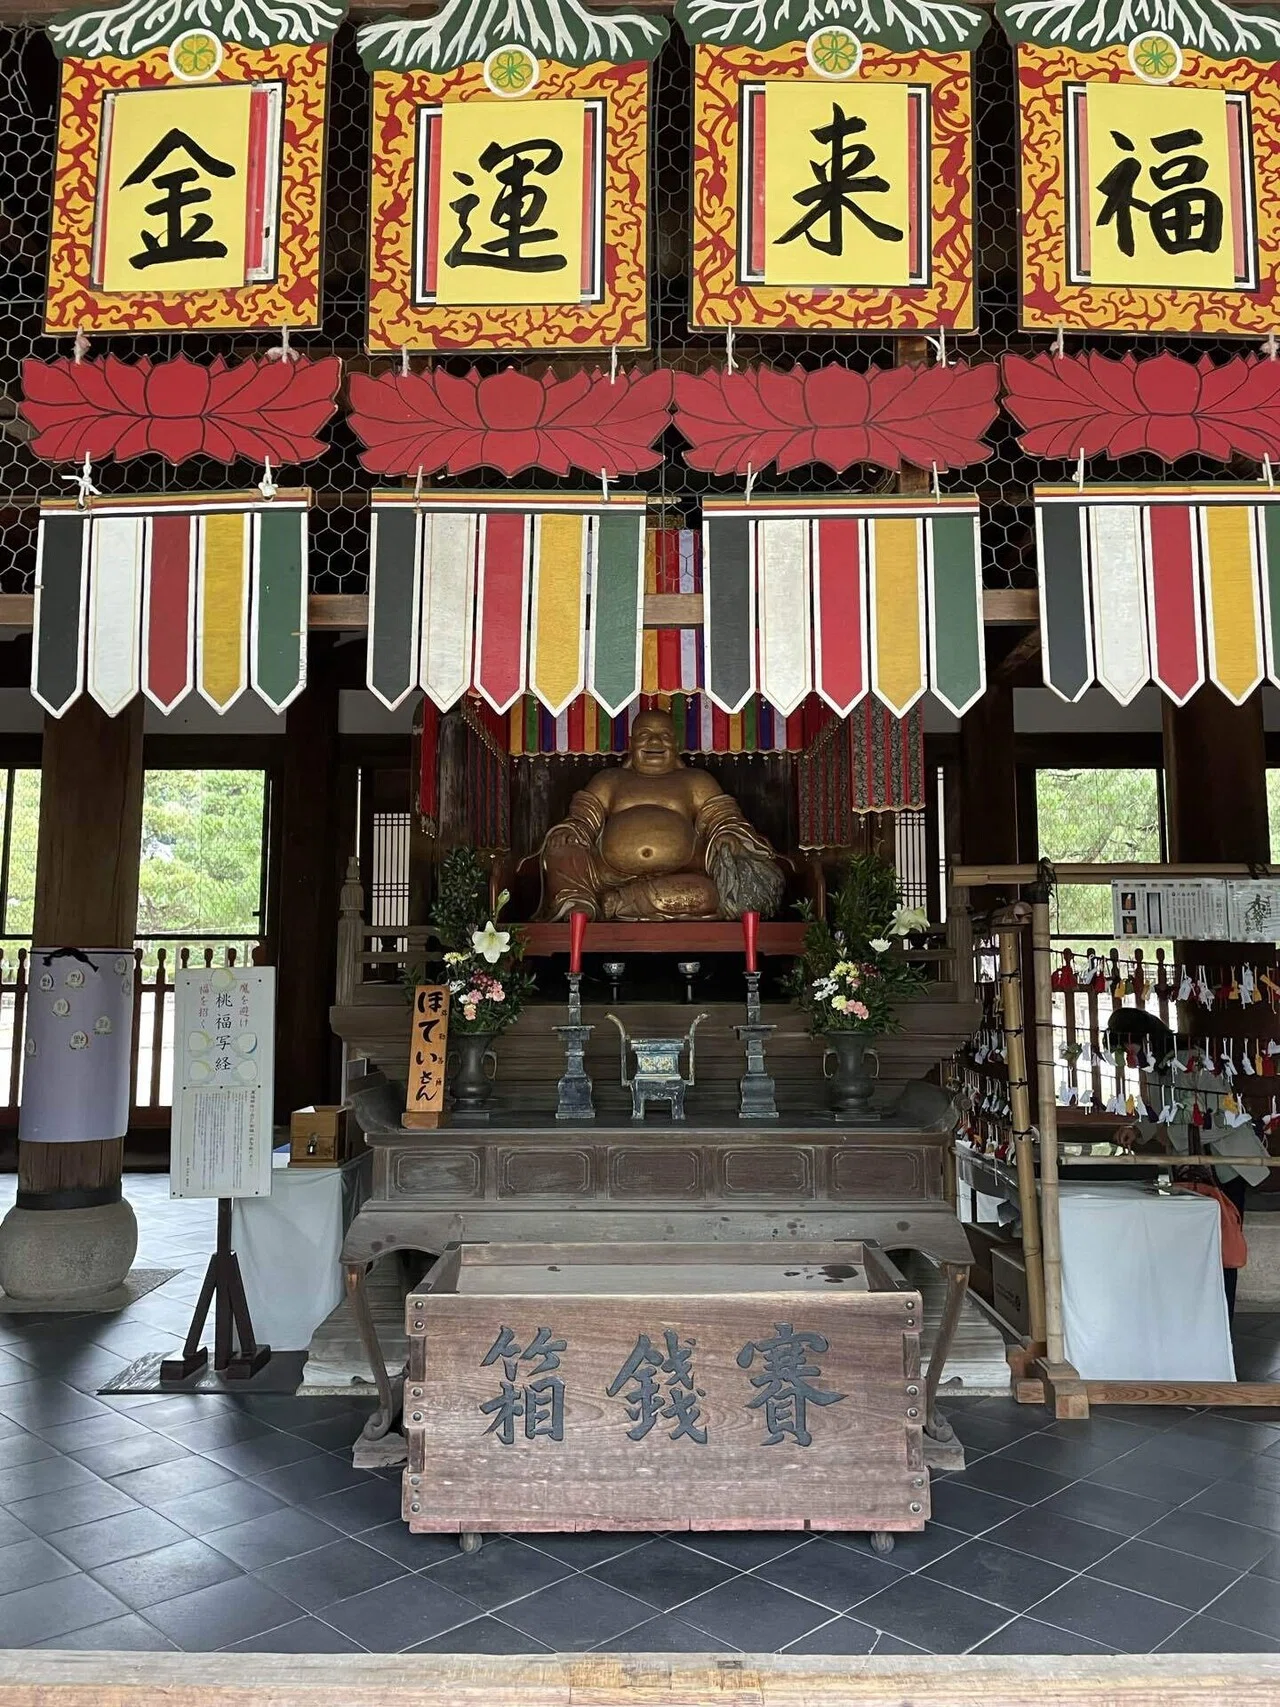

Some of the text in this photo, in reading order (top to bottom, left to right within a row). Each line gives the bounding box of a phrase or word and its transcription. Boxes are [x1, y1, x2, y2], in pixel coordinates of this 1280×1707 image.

[119, 127, 236, 270] 金
[444, 139, 567, 273] 運
[773, 101, 904, 256] 来
[1095, 127, 1224, 258] 福
[214, 992, 233, 1072] 桃福写経
[415, 990, 444, 1102] ほていさん
